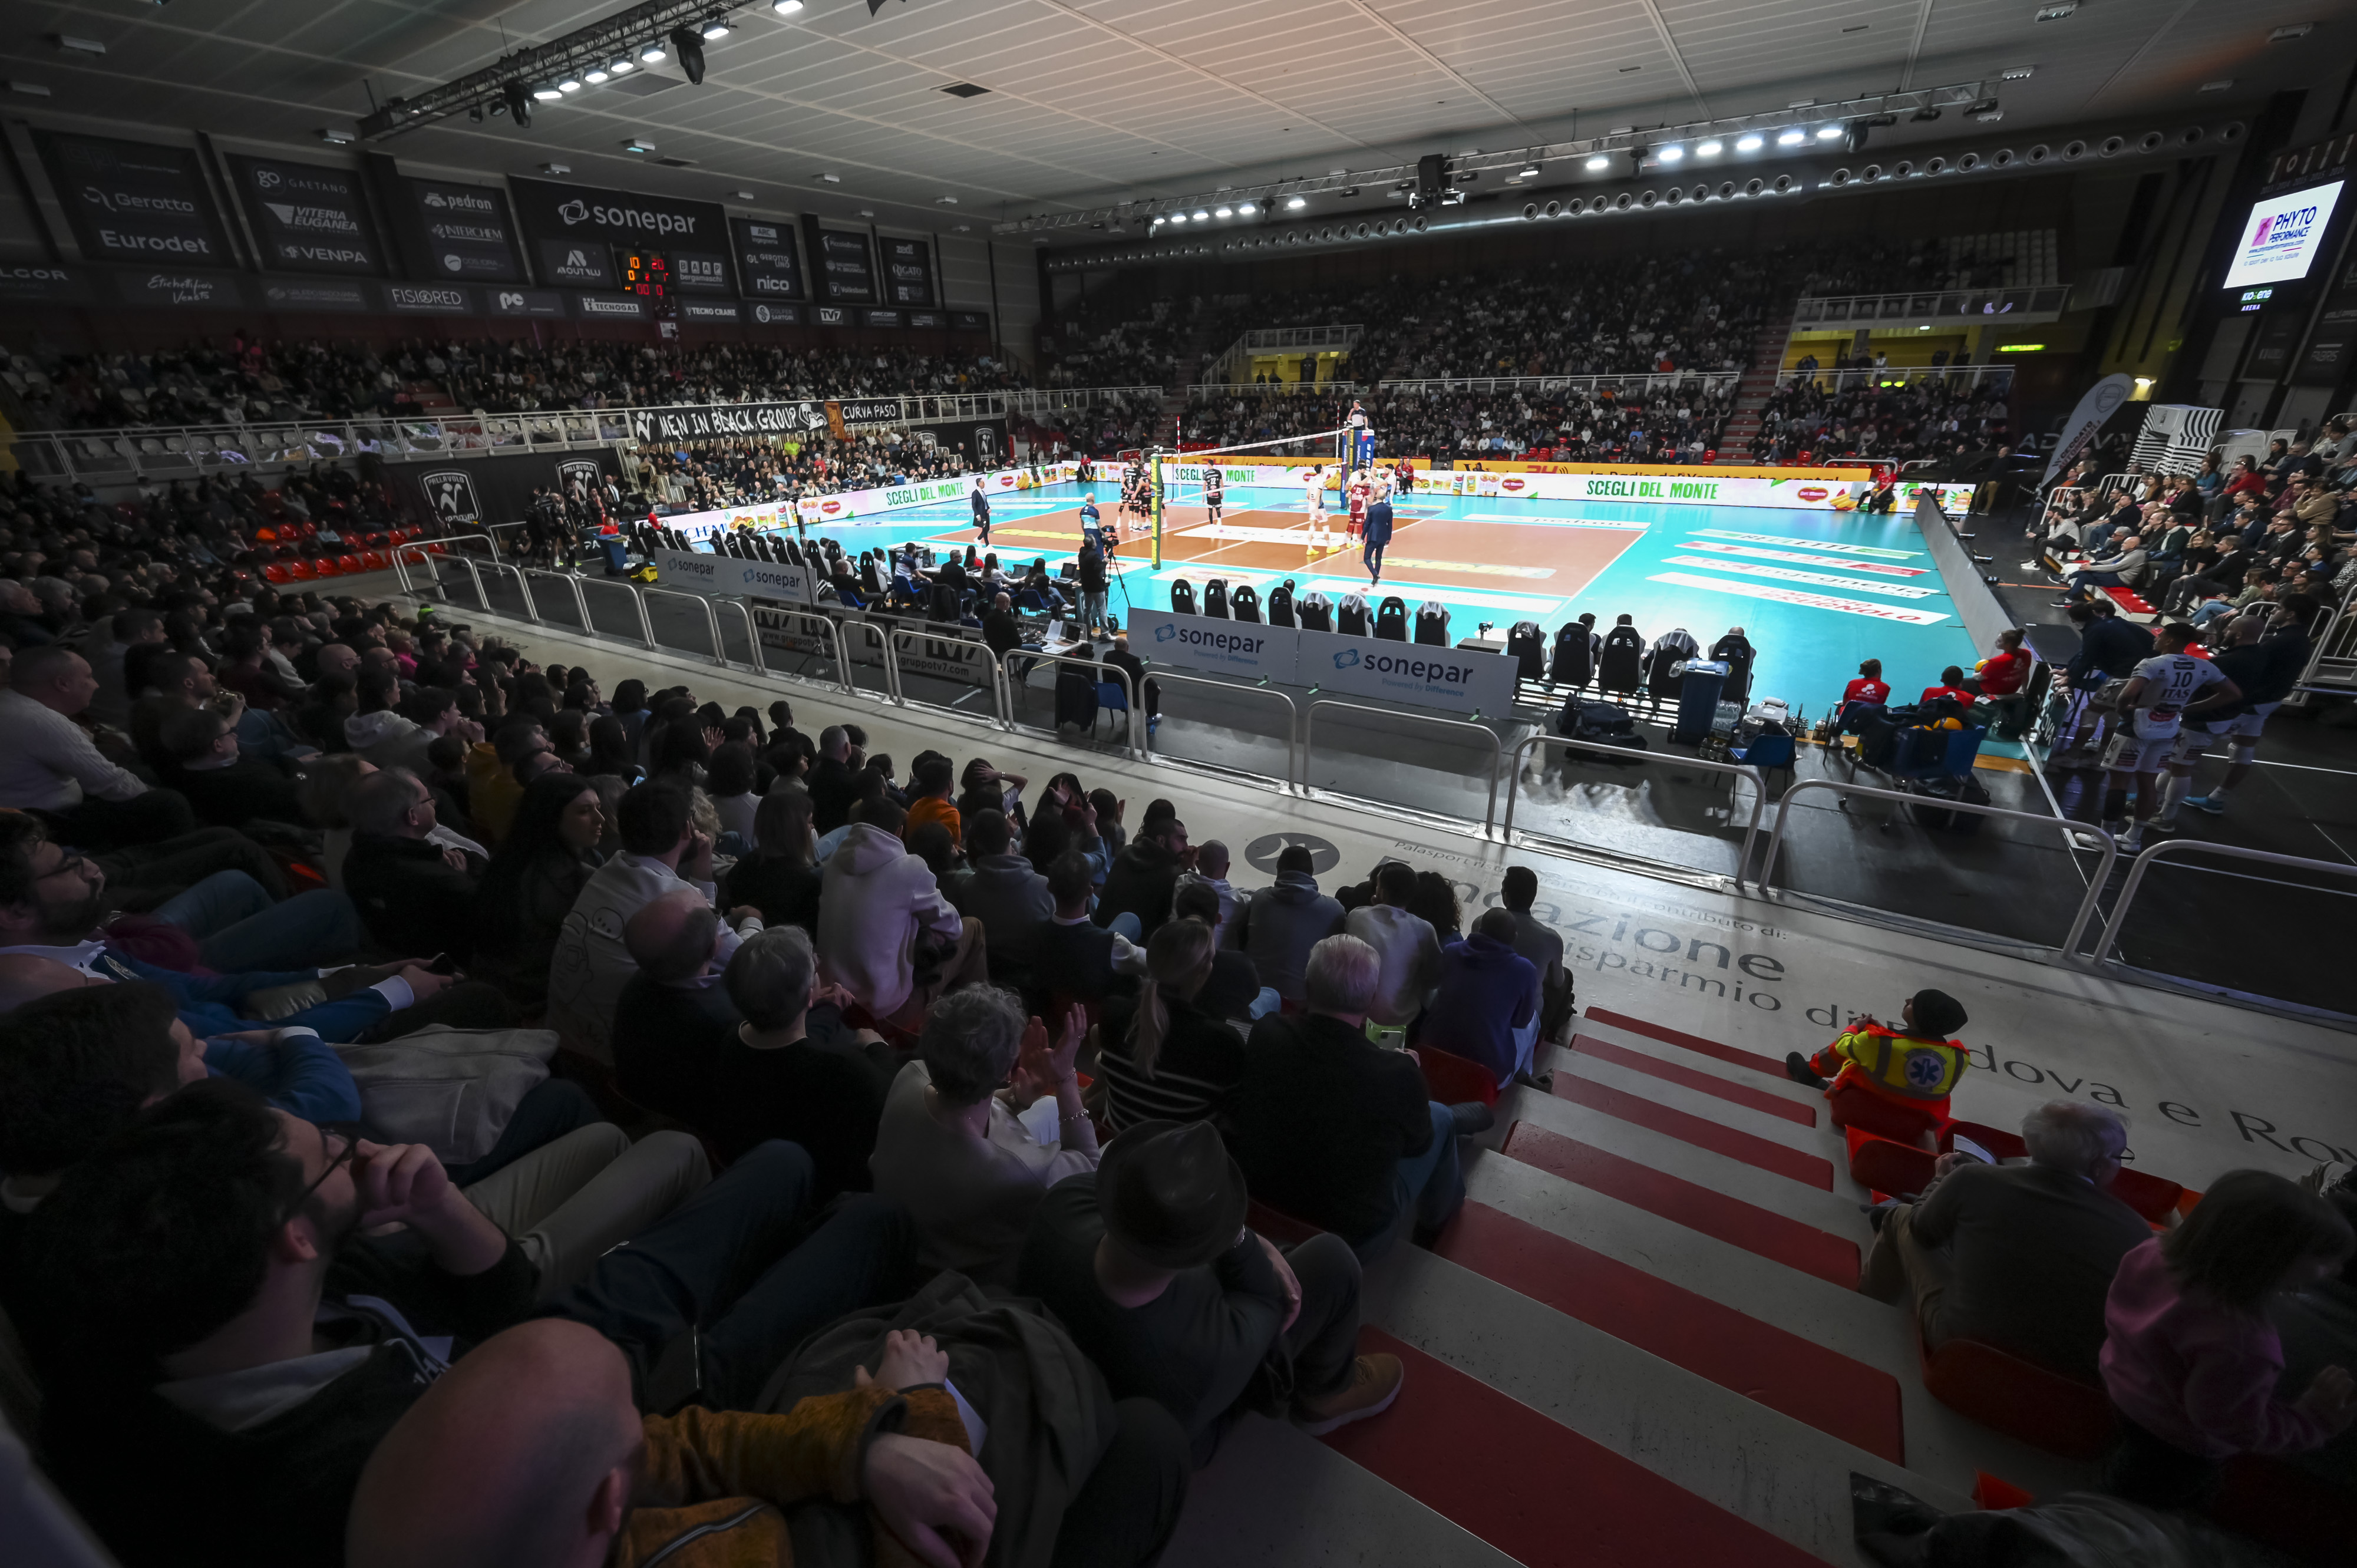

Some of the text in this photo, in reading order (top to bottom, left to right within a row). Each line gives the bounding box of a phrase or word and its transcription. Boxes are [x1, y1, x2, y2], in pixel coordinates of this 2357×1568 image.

[288, 179, 348, 194] GAETANO
[114, 193, 194, 213] Gerotto
[447, 194, 493, 210] pedron
[296, 206, 346, 220] VITERIA
[593, 204, 696, 235] sonepar
[2273, 206, 2317, 232] PHYTO
[295, 216, 358, 232] EUGANEA
[100, 229, 210, 254] Eurodet
[2268, 226, 2312, 243] PERFORMANCE
[301, 246, 368, 264] VENPA
[630, 256, 641, 269] 10
[747, 254, 759, 264] GL
[760, 254, 790, 263] GEROTTO
[628, 270, 636, 281] 0
[680, 273, 722, 282] bergamaschi
[757, 275, 790, 291] nico
[656, 285, 663, 296] 0
[692, 307, 737, 316] TECNO CRANE
[820, 308, 843, 321] TV7
[842, 404, 897, 420] CURVA PASO
[658, 407, 798, 440] MEN IN BLACK GROUP
[427, 474, 464, 486] PALLAVOLO
[1226, 470, 1256, 482] MONTE
[886, 482, 965, 506] SCEGLI DEL MONTE
[1587, 480, 1719, 500] SCEGLI DEL MONTE
[678, 559, 715, 576] sonepar
[756, 571, 801, 589] sonepar
[1178, 628, 1264, 654] sonepar
[1194, 650, 1218, 659] Powered
[1227, 655, 1259, 666] Difference
[1364, 652, 1474, 685] sonepar
[2171, 671, 2193, 688] 10
[1382, 678, 1464, 698] Powered by Difference
[2161, 689, 2191, 699] ITAS
[1394, 840, 1470, 867] Palasport
[1642, 900, 1754, 932] contributo
[1761, 926, 1788, 940] di:
[1563, 936, 1782, 1013] isparmio
[1805, 1003, 1856, 1030] di
[2158, 1100, 2201, 1127] e
